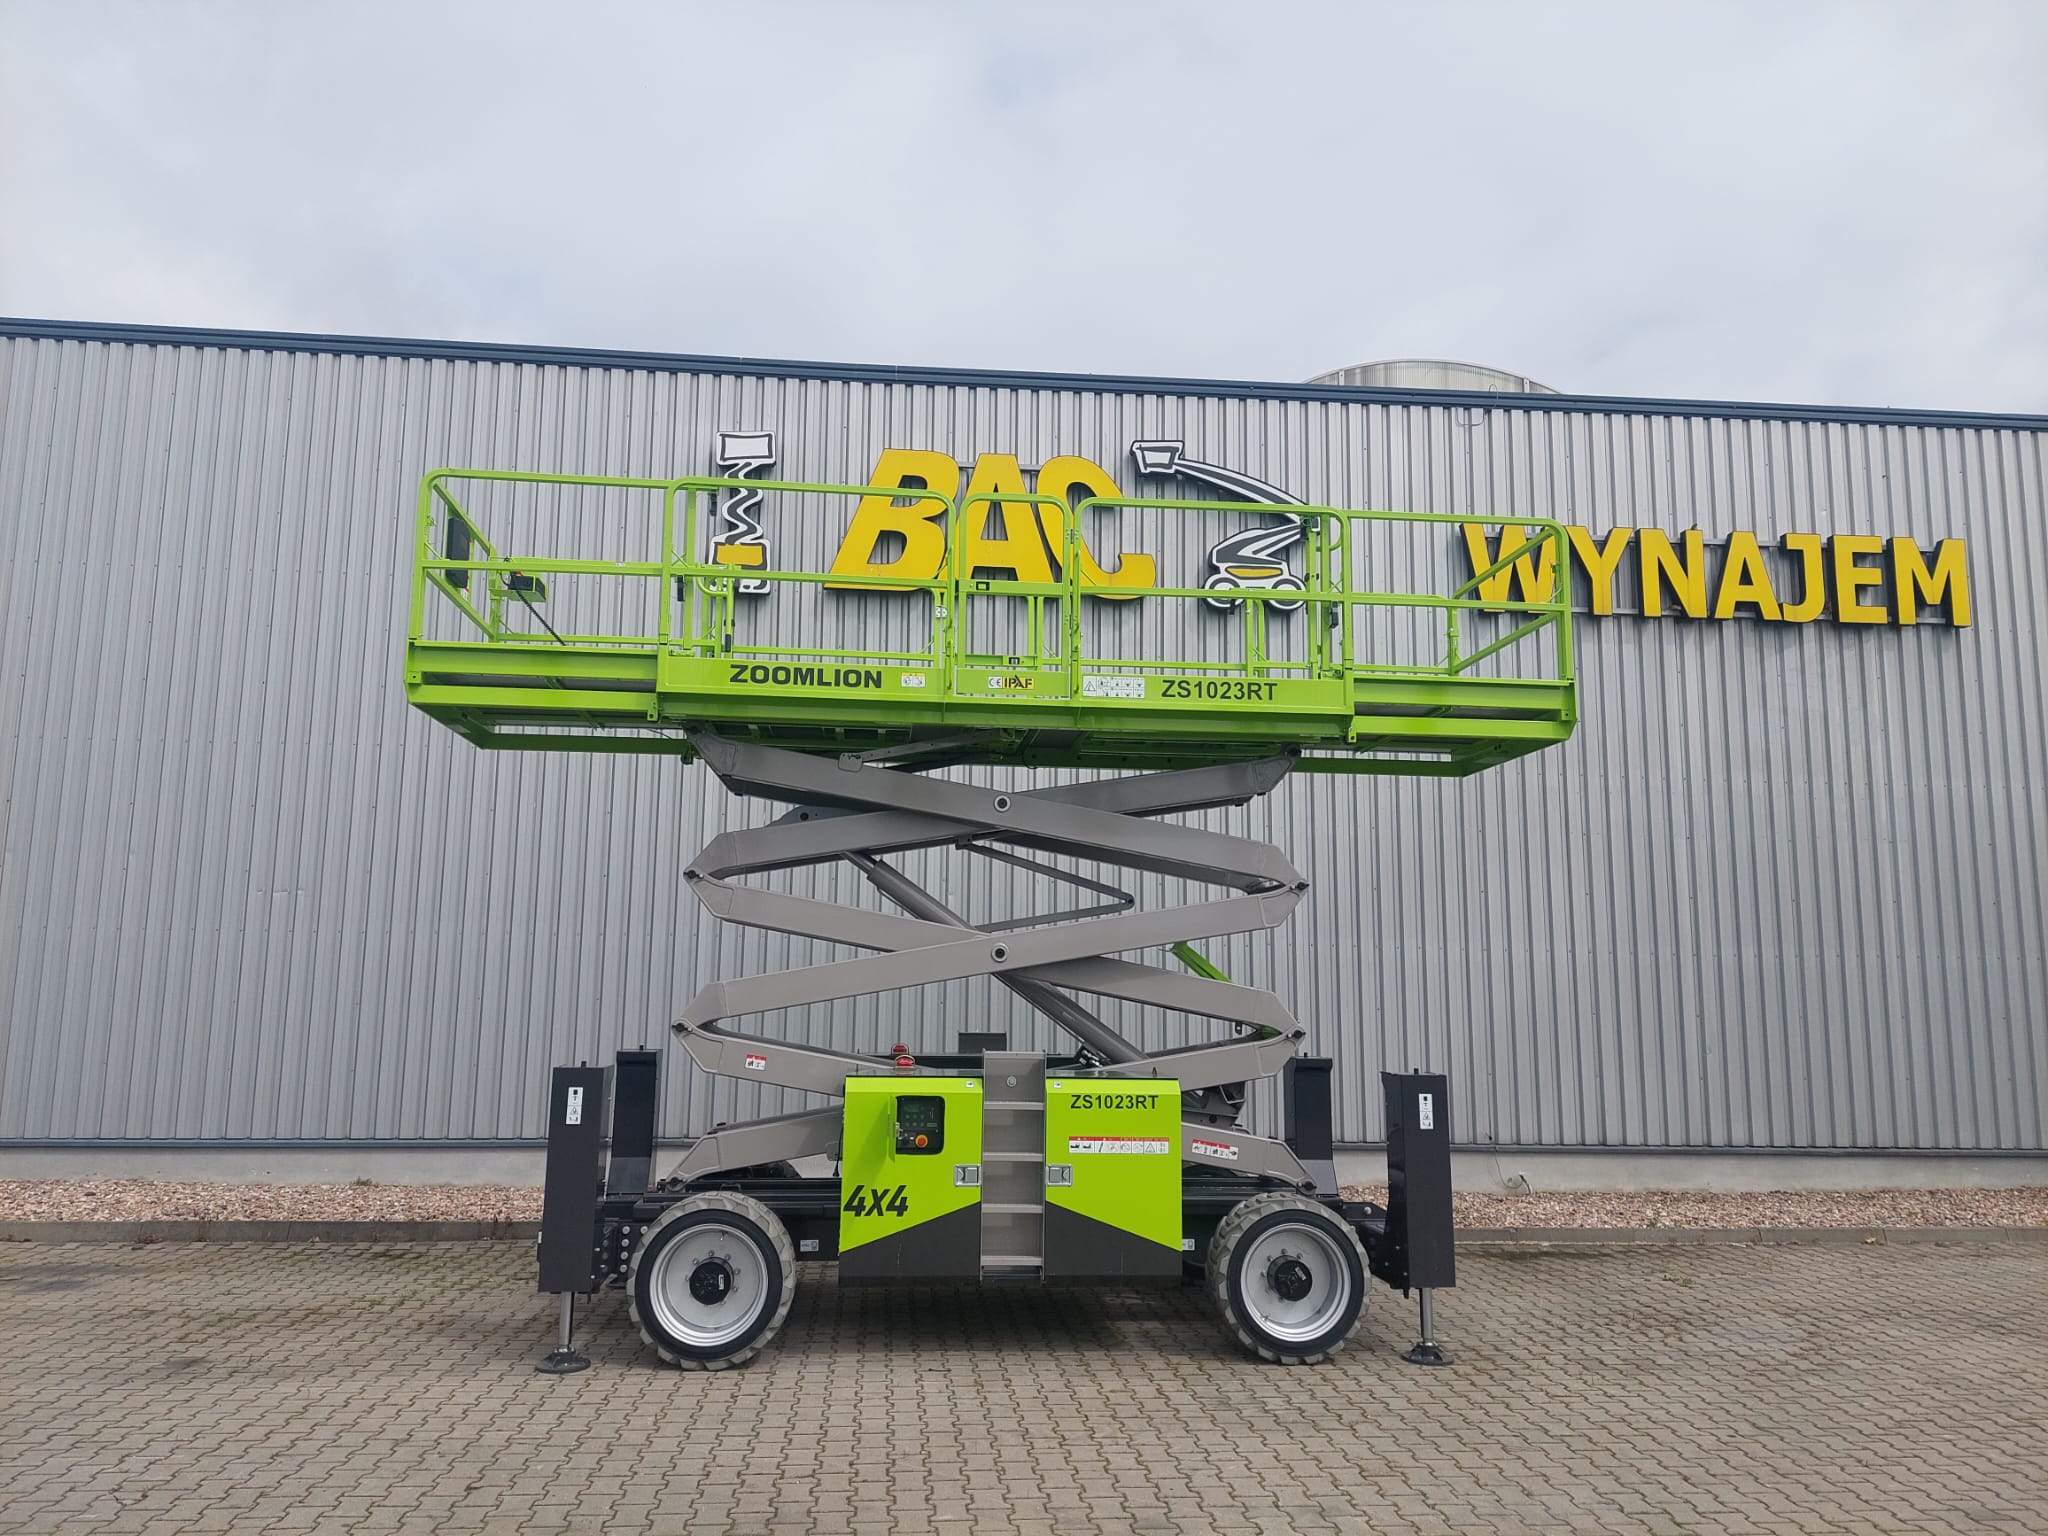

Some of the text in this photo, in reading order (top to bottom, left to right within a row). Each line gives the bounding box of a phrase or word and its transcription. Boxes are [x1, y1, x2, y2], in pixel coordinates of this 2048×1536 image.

[823, 448, 1156, 601] BAC
[1461, 523, 1971, 627] WYNAJEM
[730, 664, 882, 688] ZOOMLION
[1004, 675, 1033, 689] IPAF
[1161, 680, 1278, 700] ZS1023RT
[1070, 1094, 1159, 1110] ZS1023RT
